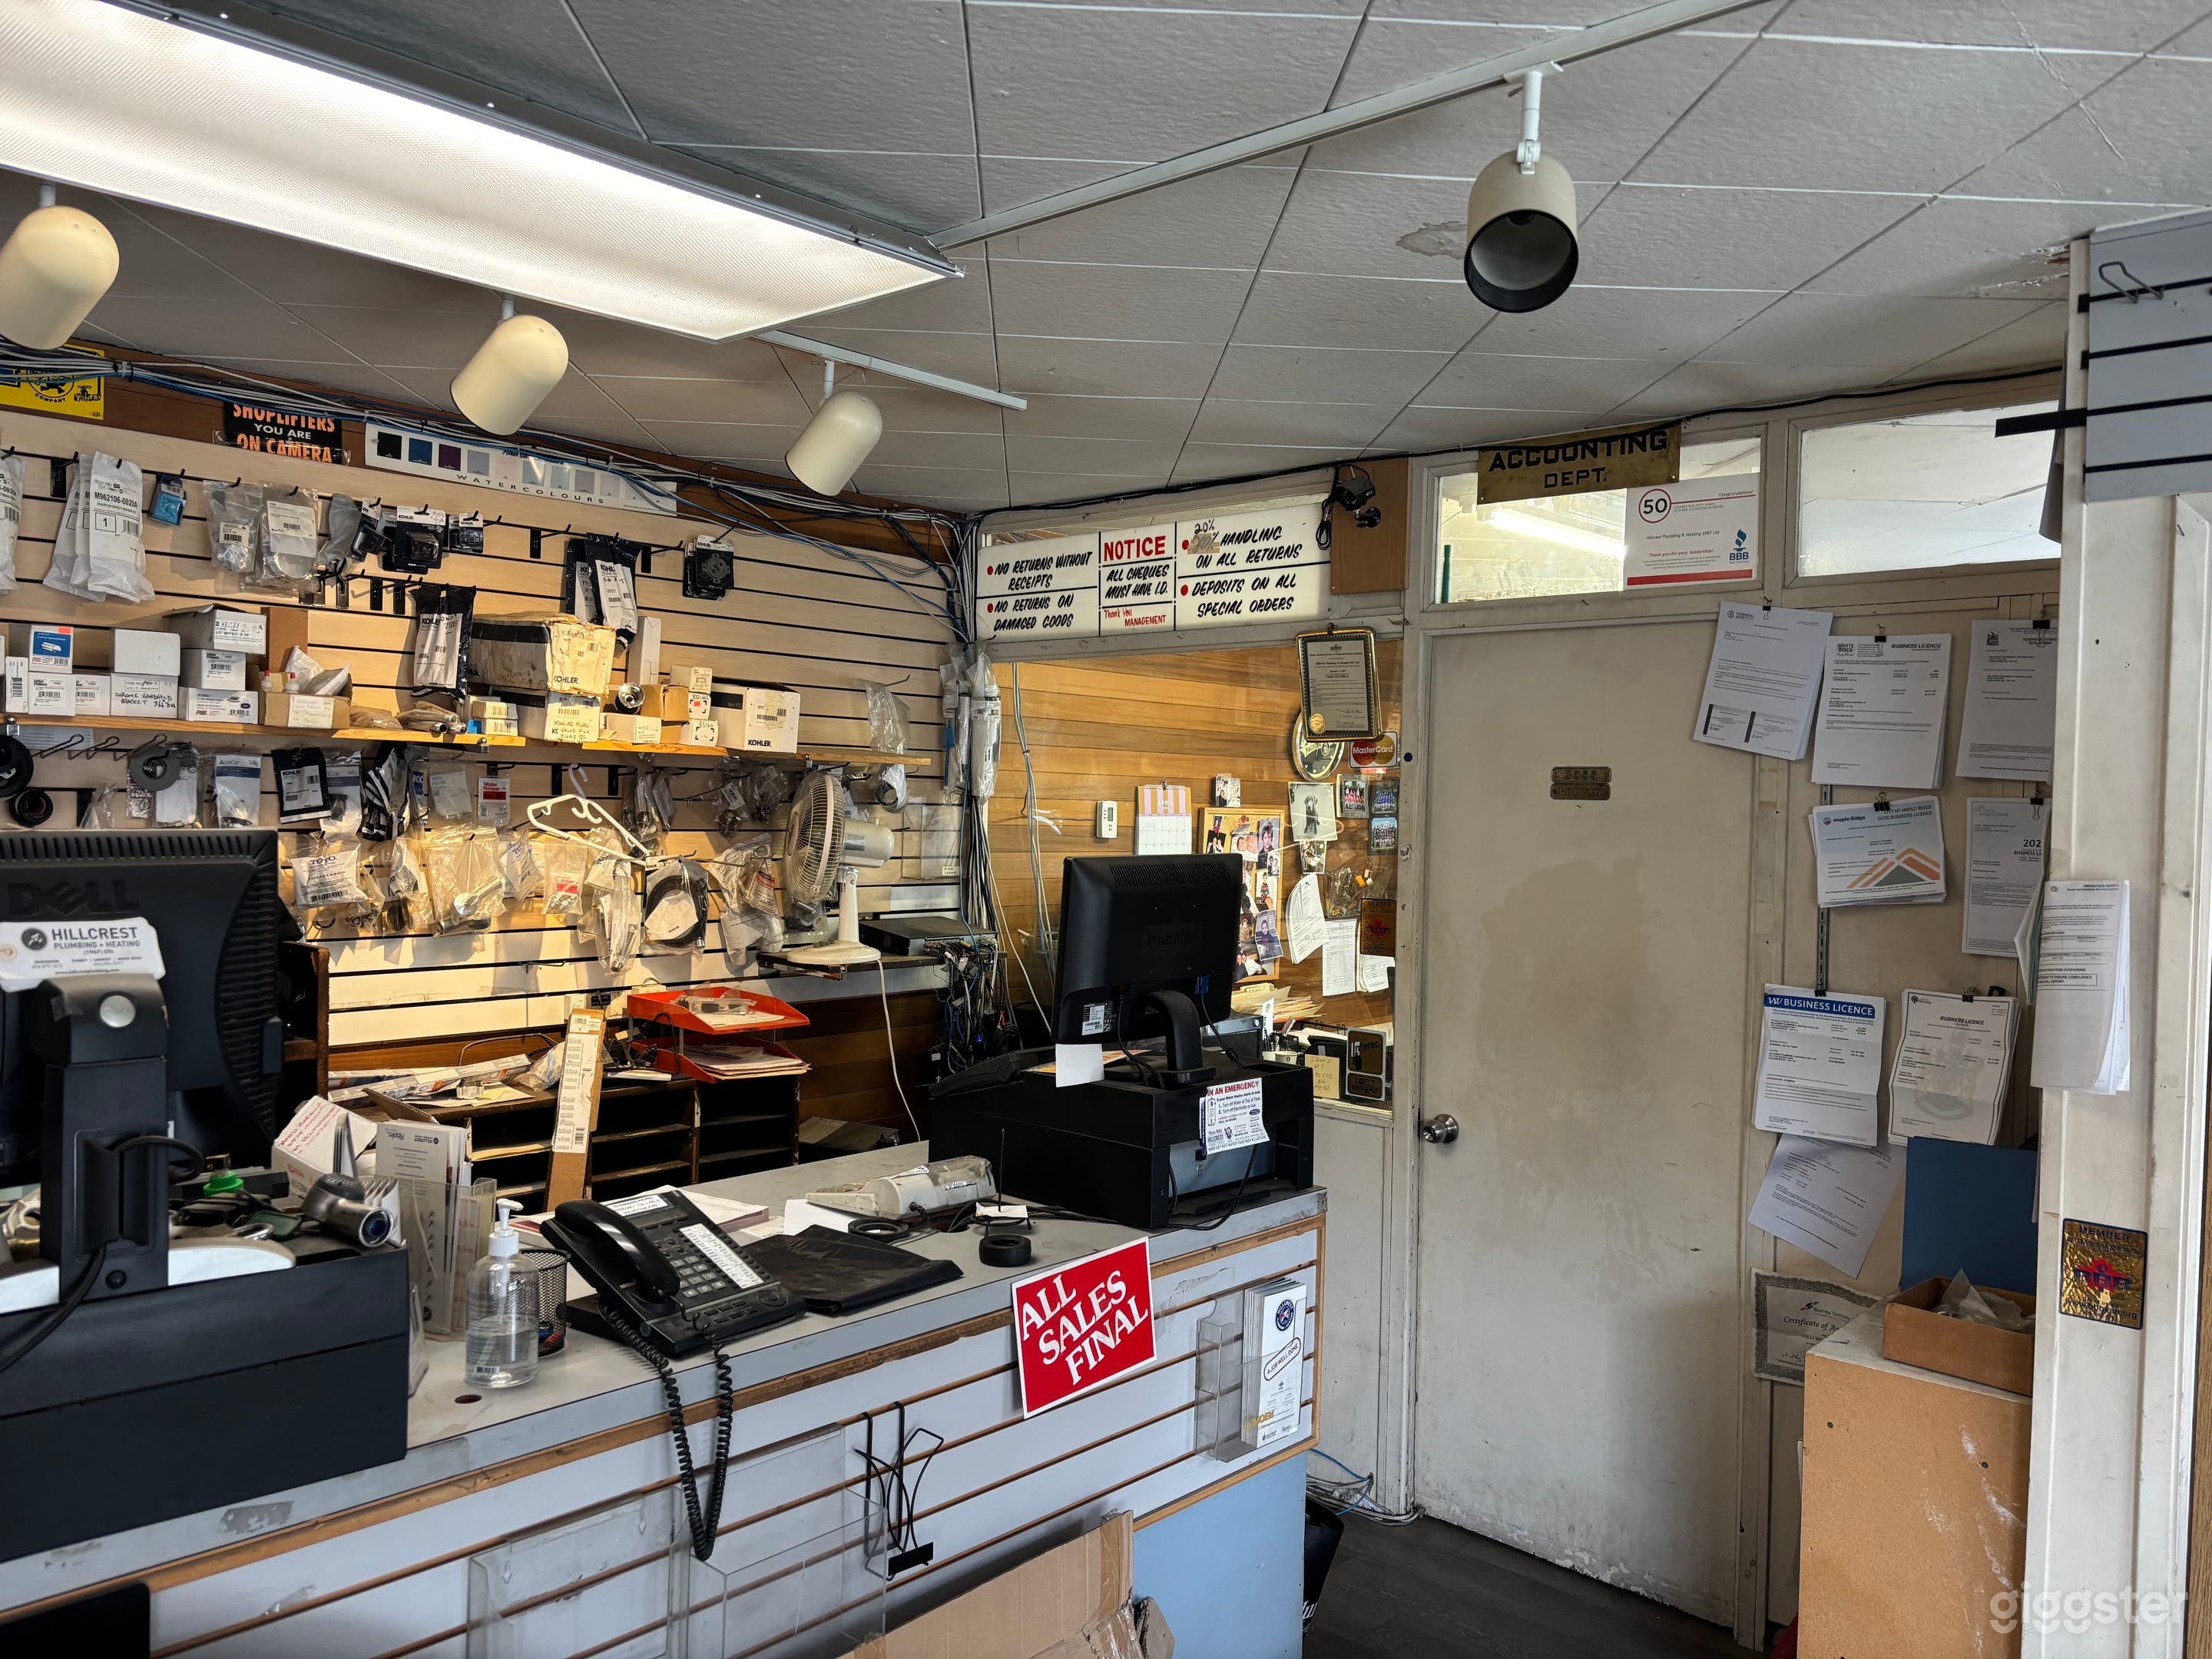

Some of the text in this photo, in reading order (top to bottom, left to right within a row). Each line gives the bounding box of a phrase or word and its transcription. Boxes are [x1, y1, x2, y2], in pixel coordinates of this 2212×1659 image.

[35, 392, 66, 403] COMPANY
[254, 423, 312, 439] YOU ARE
[237, 433, 333, 463] ON CAMERA
[1488, 429, 1668, 472] ACCOUNTING
[1544, 467, 1608, 488] DEPT.
[456, 474, 605, 505] WATERCOLOURS
[1718, 489, 1754, 498] Congratulations!
[1643, 498, 1667, 515] 50
[103, 518, 108, 527] 1
[1220, 525, 1282, 546] HANDLING
[1104, 535, 1166, 561] NOTICE
[1196, 543, 1303, 568] ON ALL RETURNS
[995, 551, 1093, 575] NO RETURNS WITHOUT
[1729, 552, 1749, 561] BBB
[1107, 565, 1170, 582] ALL CHEQUES
[1008, 575, 1053, 591] RECEIPTS
[1105, 581, 1167, 599] MUST HAVE I.D.
[1192, 573, 1296, 596] DEPOSITS ON ALL
[995, 593, 1074, 613] NO RETURNS ON
[1197, 596, 1294, 618] SPECIAL ORDERS
[1104, 608, 1132, 619] Thank You
[1124, 614, 1166, 627] MANAGEMENT
[994, 614, 1073, 631] DAMAGED GOODS
[748, 739, 771, 747] KOHLER
[1353, 745, 1393, 754] MasterCard
[2023, 839, 2041, 848] 202
[7, 880, 141, 916] DELL
[51, 927, 138, 940] HILLCREST
[54, 941, 98, 949] PLUMBING
[1783, 998, 1873, 1015] BUSINESS LICENCE
[1352, 1041, 1380, 1054] Interac
[1225, 1081, 1259, 1093] EMERGENCY
[1352, 1084, 1380, 1094] PAYMENT
[1355, 1078, 1375, 1088] DIRECT
[2079, 1227, 2131, 1241] MEMBER
[1022, 1274, 1076, 1341] ALL
[1277, 1299, 1293, 1314] HILLCREST
[1813, 1306, 1831, 1315] Surrey
[1038, 1270, 1126, 1365] SALES
[1783, 1316, 1820, 1328] Certificate
[1065, 1295, 1148, 1386] FINAL
[1270, 1362, 1279, 1372] JOB
[1278, 1354, 1289, 1366] WELL
[1287, 1343, 1299, 1359] DONE
